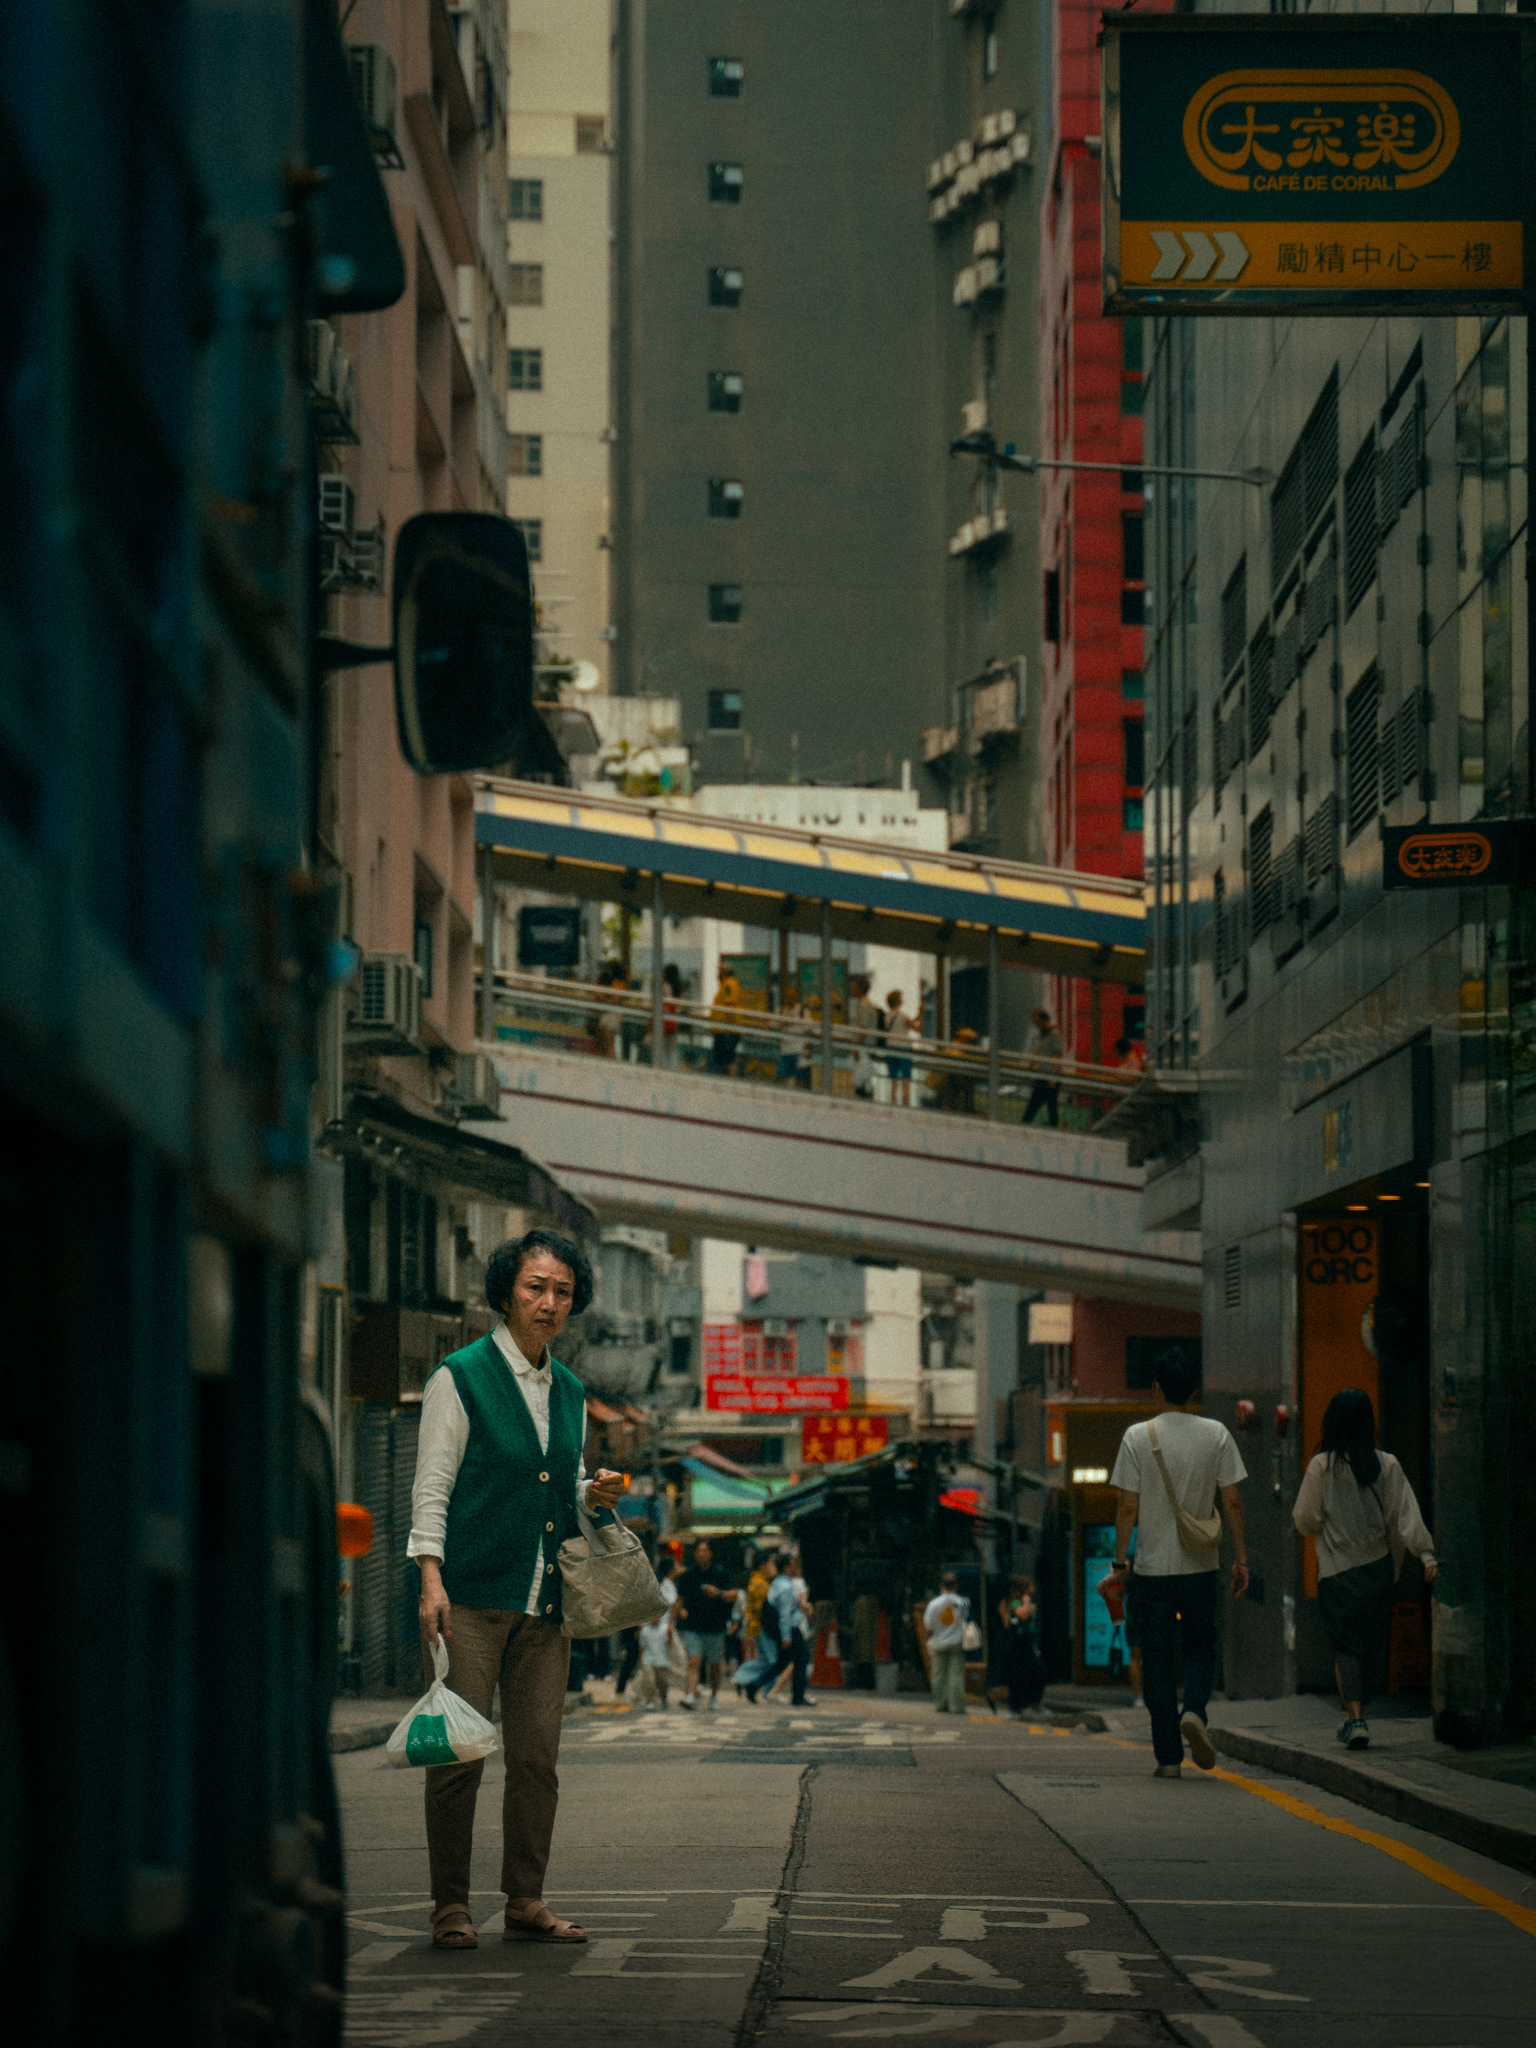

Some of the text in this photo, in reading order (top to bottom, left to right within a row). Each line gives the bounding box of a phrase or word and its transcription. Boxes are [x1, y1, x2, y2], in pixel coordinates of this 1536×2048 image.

[1253, 172, 1393, 191] CAFÉ DE CORAL
[1307, 1226, 1373, 1254] 100
[1306, 1257, 1373, 1284] QRC
